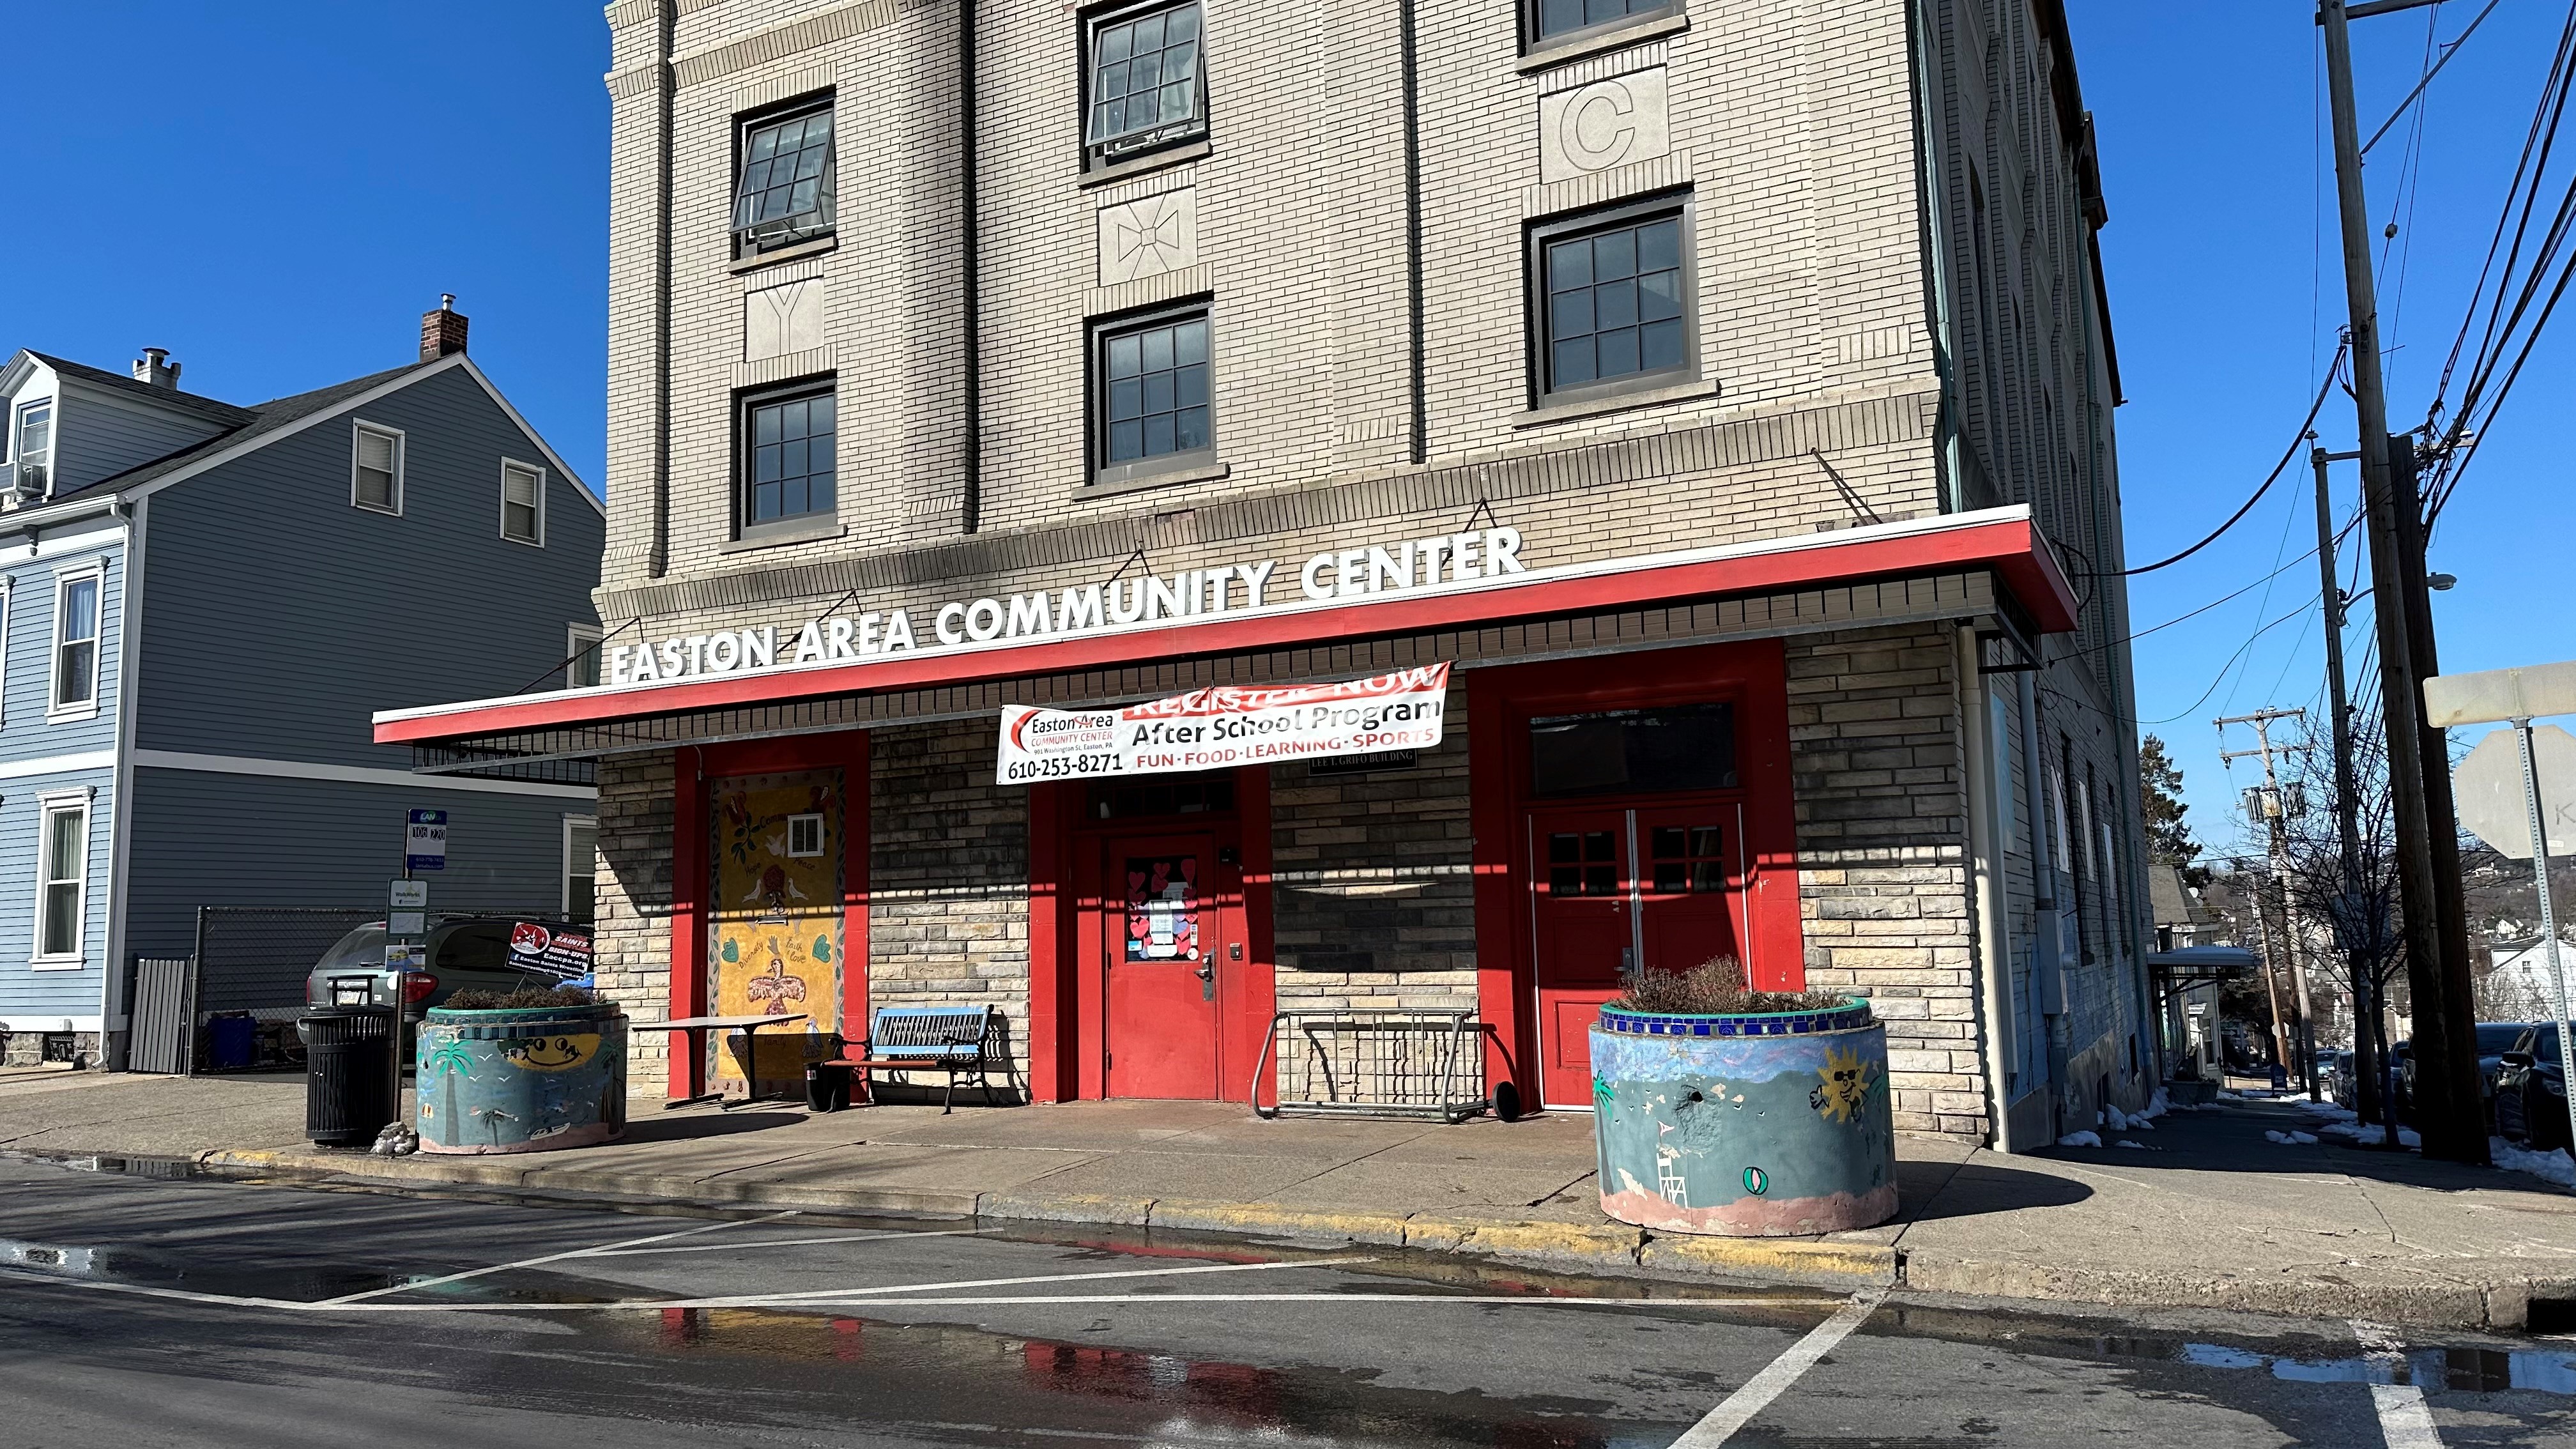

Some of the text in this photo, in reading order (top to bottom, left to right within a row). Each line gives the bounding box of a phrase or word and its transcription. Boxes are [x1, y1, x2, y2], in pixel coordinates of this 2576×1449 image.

[1560, 80, 1636, 171] C
[611, 526, 1528, 684] EASTON AREA COMMUNITY CENTER
[1333, 663, 1442, 696] NOW
[1032, 713, 1113, 733] Easton Area
[1132, 701, 1440, 746] After School Program
[1031, 731, 1113, 747] COMMUNITY CENTER
[1137, 728, 1434, 767] FUN FOOD LEARNING SPORTS
[1044, 746, 1074, 755] Washington
[1312, 750, 1413, 767] LEE T. GRIFO BUILDING
[1008, 753, 1123, 779] 610-253-8271
[413, 827, 445, 839] 106 220
[744, 862, 762, 877] Hope
[792, 857, 815, 871] Peace
[555, 936, 588, 947] SAINTS
[548, 947, 588, 959] SIGN-UPS
[739, 941, 763, 969] Diversity
